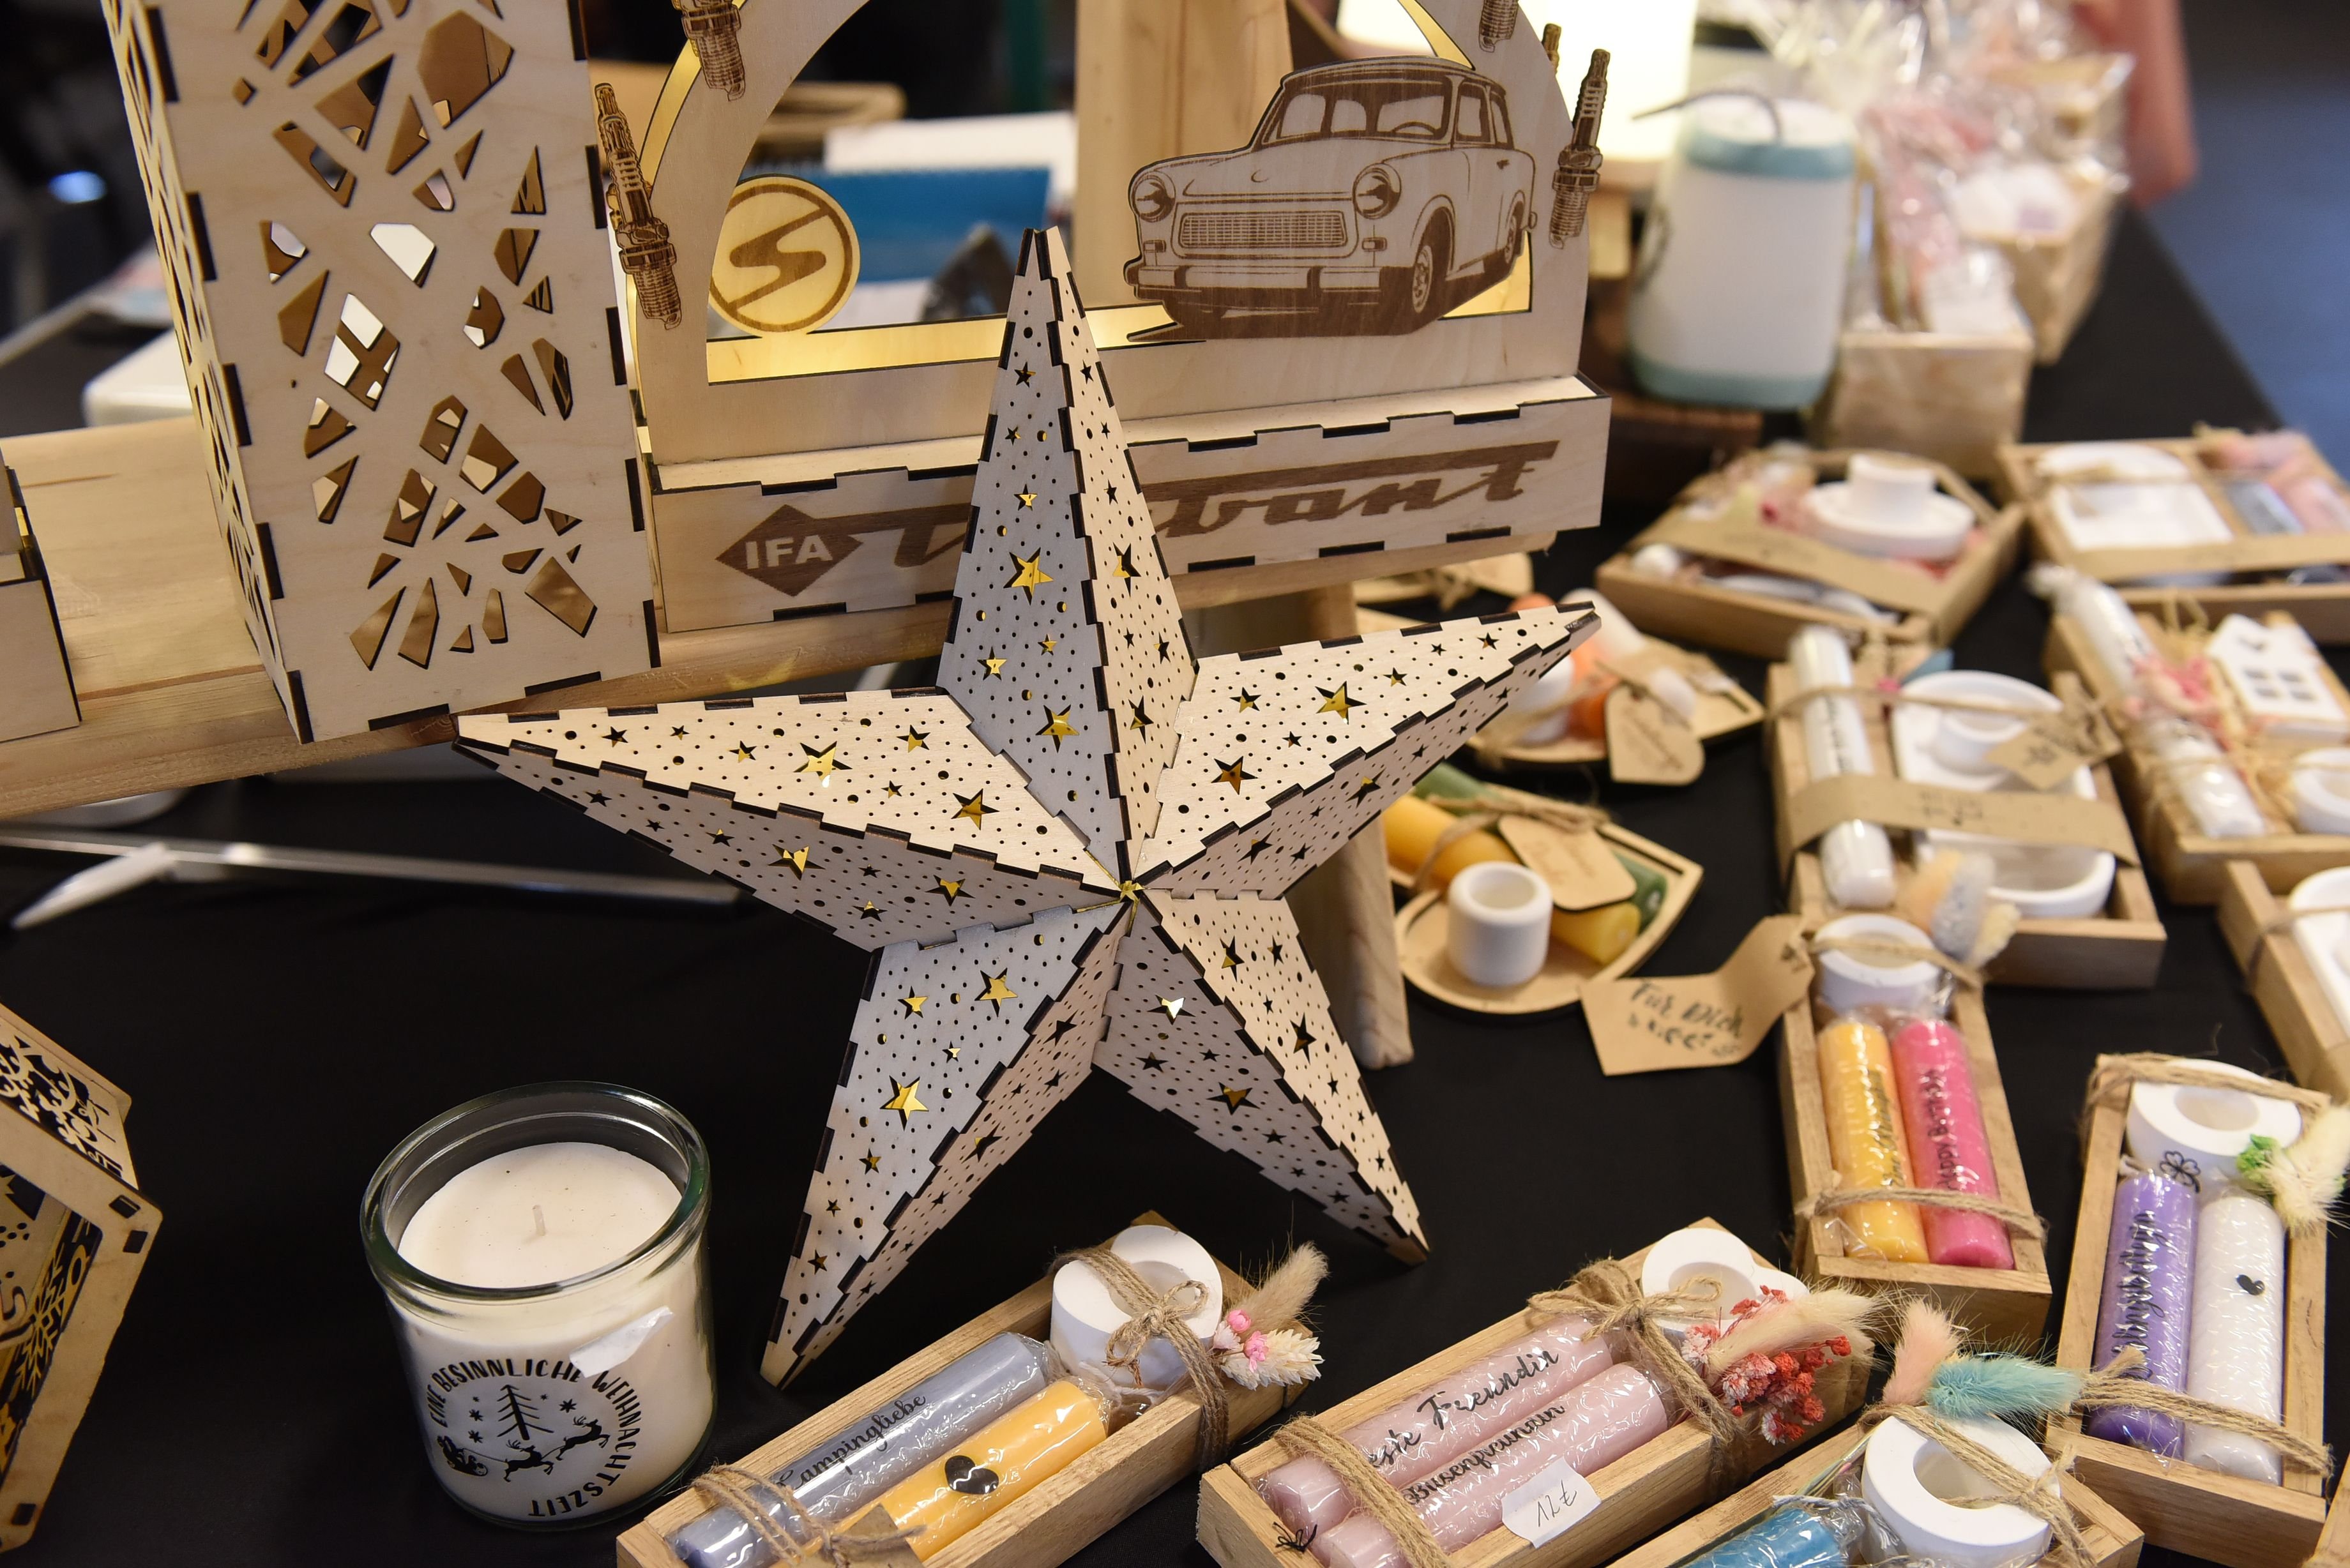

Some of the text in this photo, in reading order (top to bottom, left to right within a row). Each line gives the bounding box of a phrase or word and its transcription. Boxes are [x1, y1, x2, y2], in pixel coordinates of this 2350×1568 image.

[745, 534, 833, 569] IFA
[427, 1359, 641, 1517] EINE BESINNLICHE WEIHNACHTSZEIT
[776, 1396, 926, 1491] Campingliebe
[1368, 1350, 1558, 1468] este Freundin
[1404, 1405, 1565, 1505] Busenfreundin
